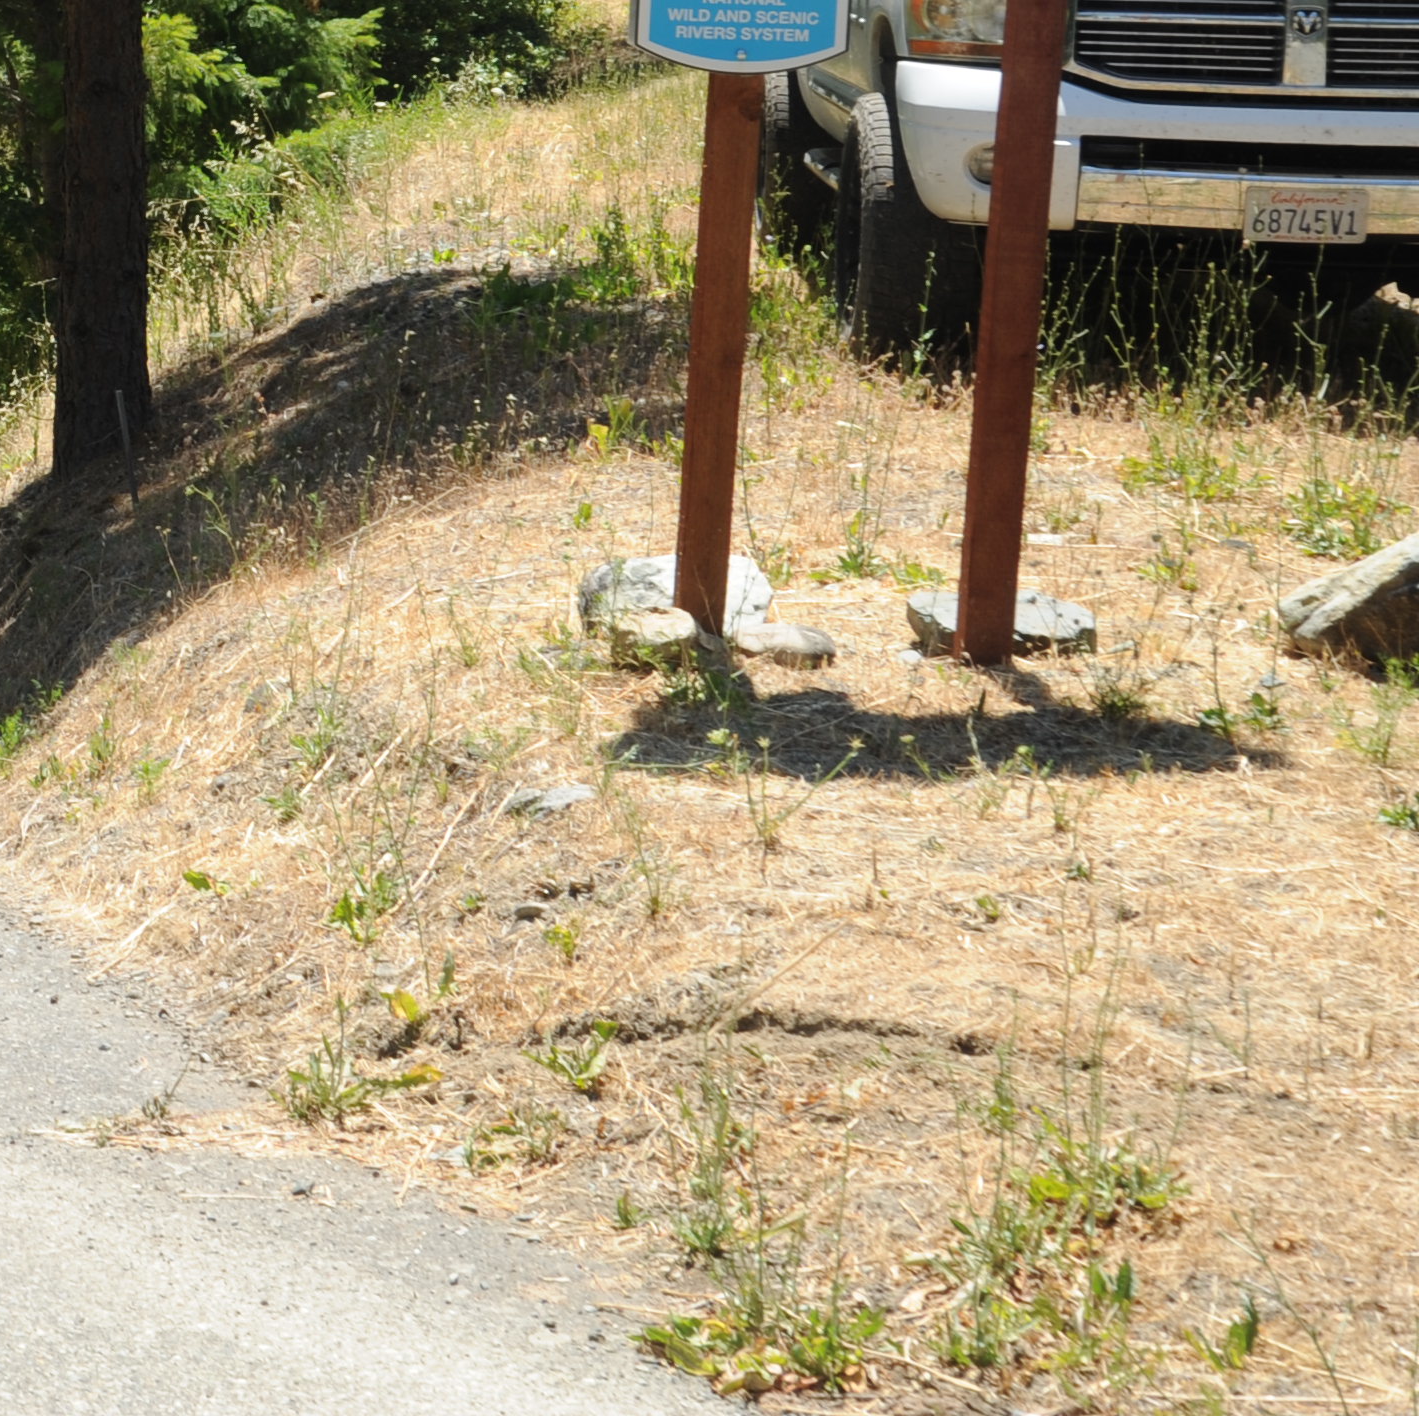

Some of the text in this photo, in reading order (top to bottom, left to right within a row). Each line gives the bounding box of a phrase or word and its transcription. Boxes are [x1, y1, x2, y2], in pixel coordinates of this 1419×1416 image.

[668, 8, 820, 25] WILD AND SCENIC
[675, 25, 810, 42] RIVERS SYSTEM
[1271, 191, 1343, 208] California
[1252, 208, 1358, 235] 68745V1
